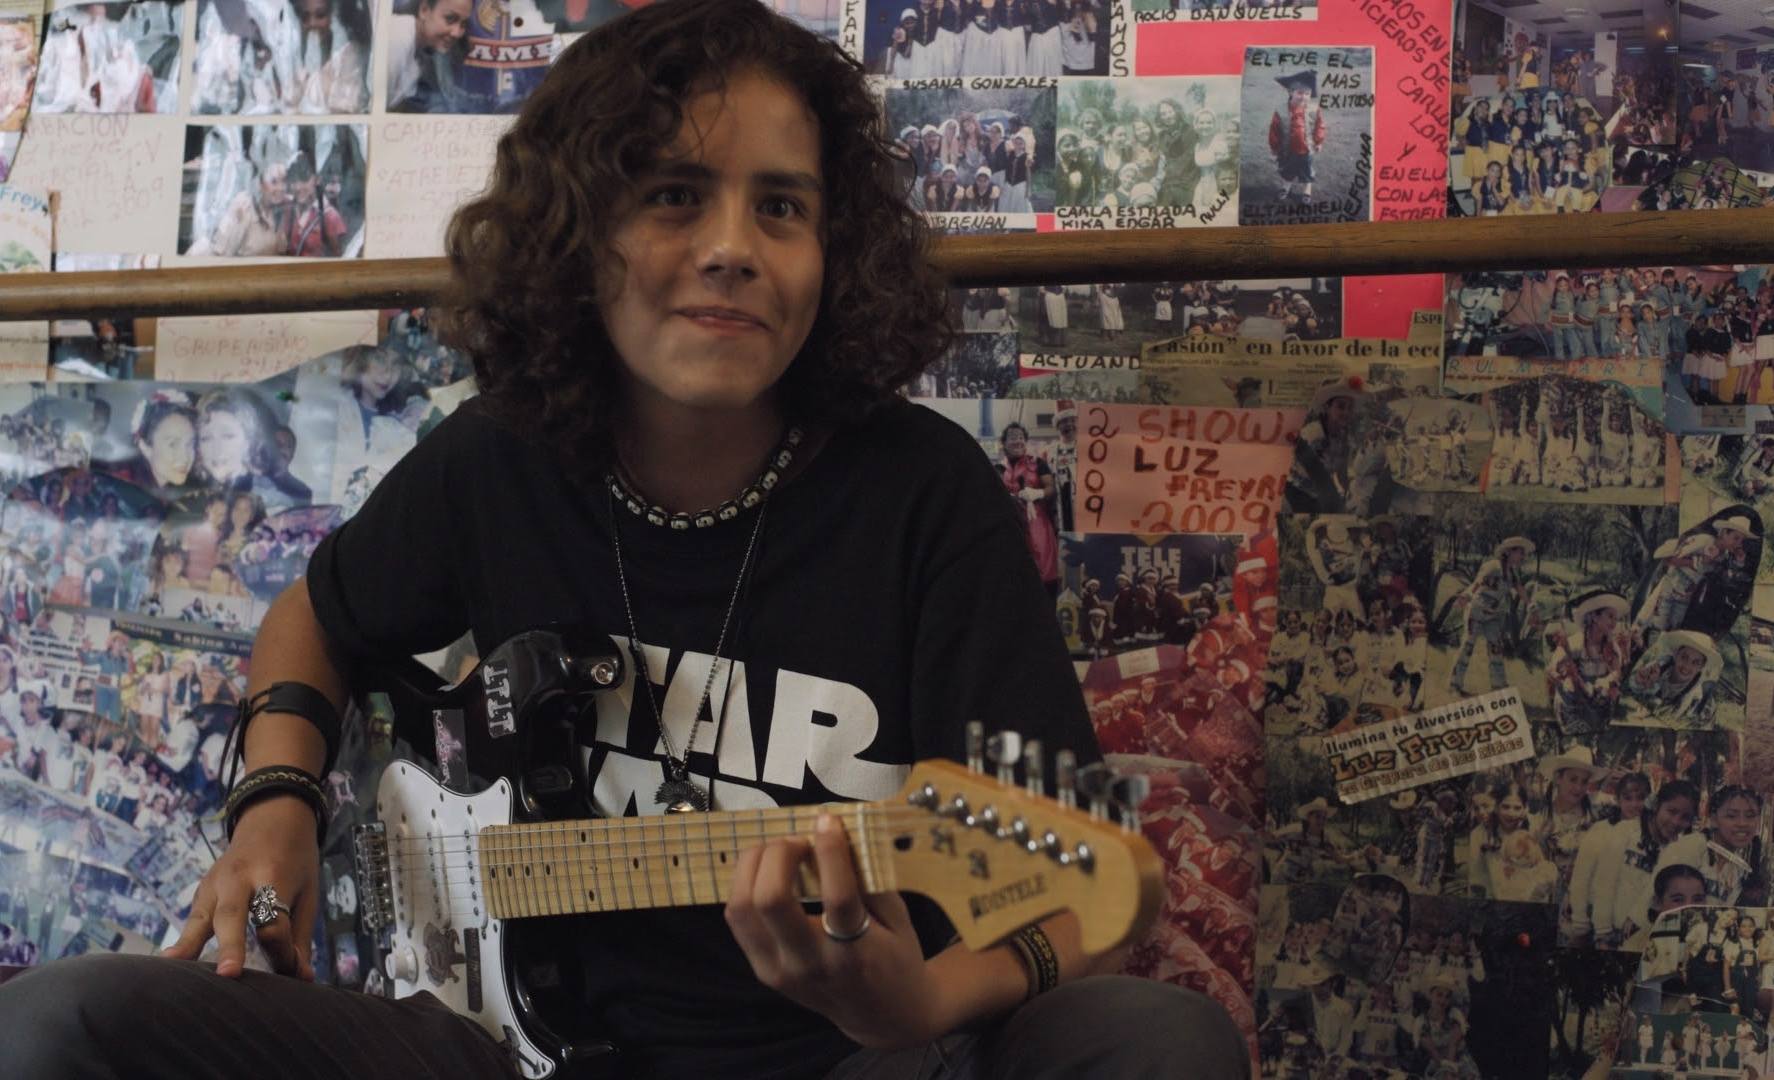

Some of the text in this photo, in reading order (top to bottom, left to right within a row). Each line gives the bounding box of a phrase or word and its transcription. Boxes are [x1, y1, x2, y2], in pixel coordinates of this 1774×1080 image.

[1321, 73, 1361, 89] MAS
[1374, 187, 1414, 204] CON
[1246, 342, 1273, 356] en
[1344, 339, 1374, 357] de
[1378, 339, 1400, 357] la
[1133, 446, 1220, 480] LUZ
[1391, 724, 1409, 736] tu
[1490, 695, 1517, 710] con
[1330, 714, 1518, 781] Luz Freyre
